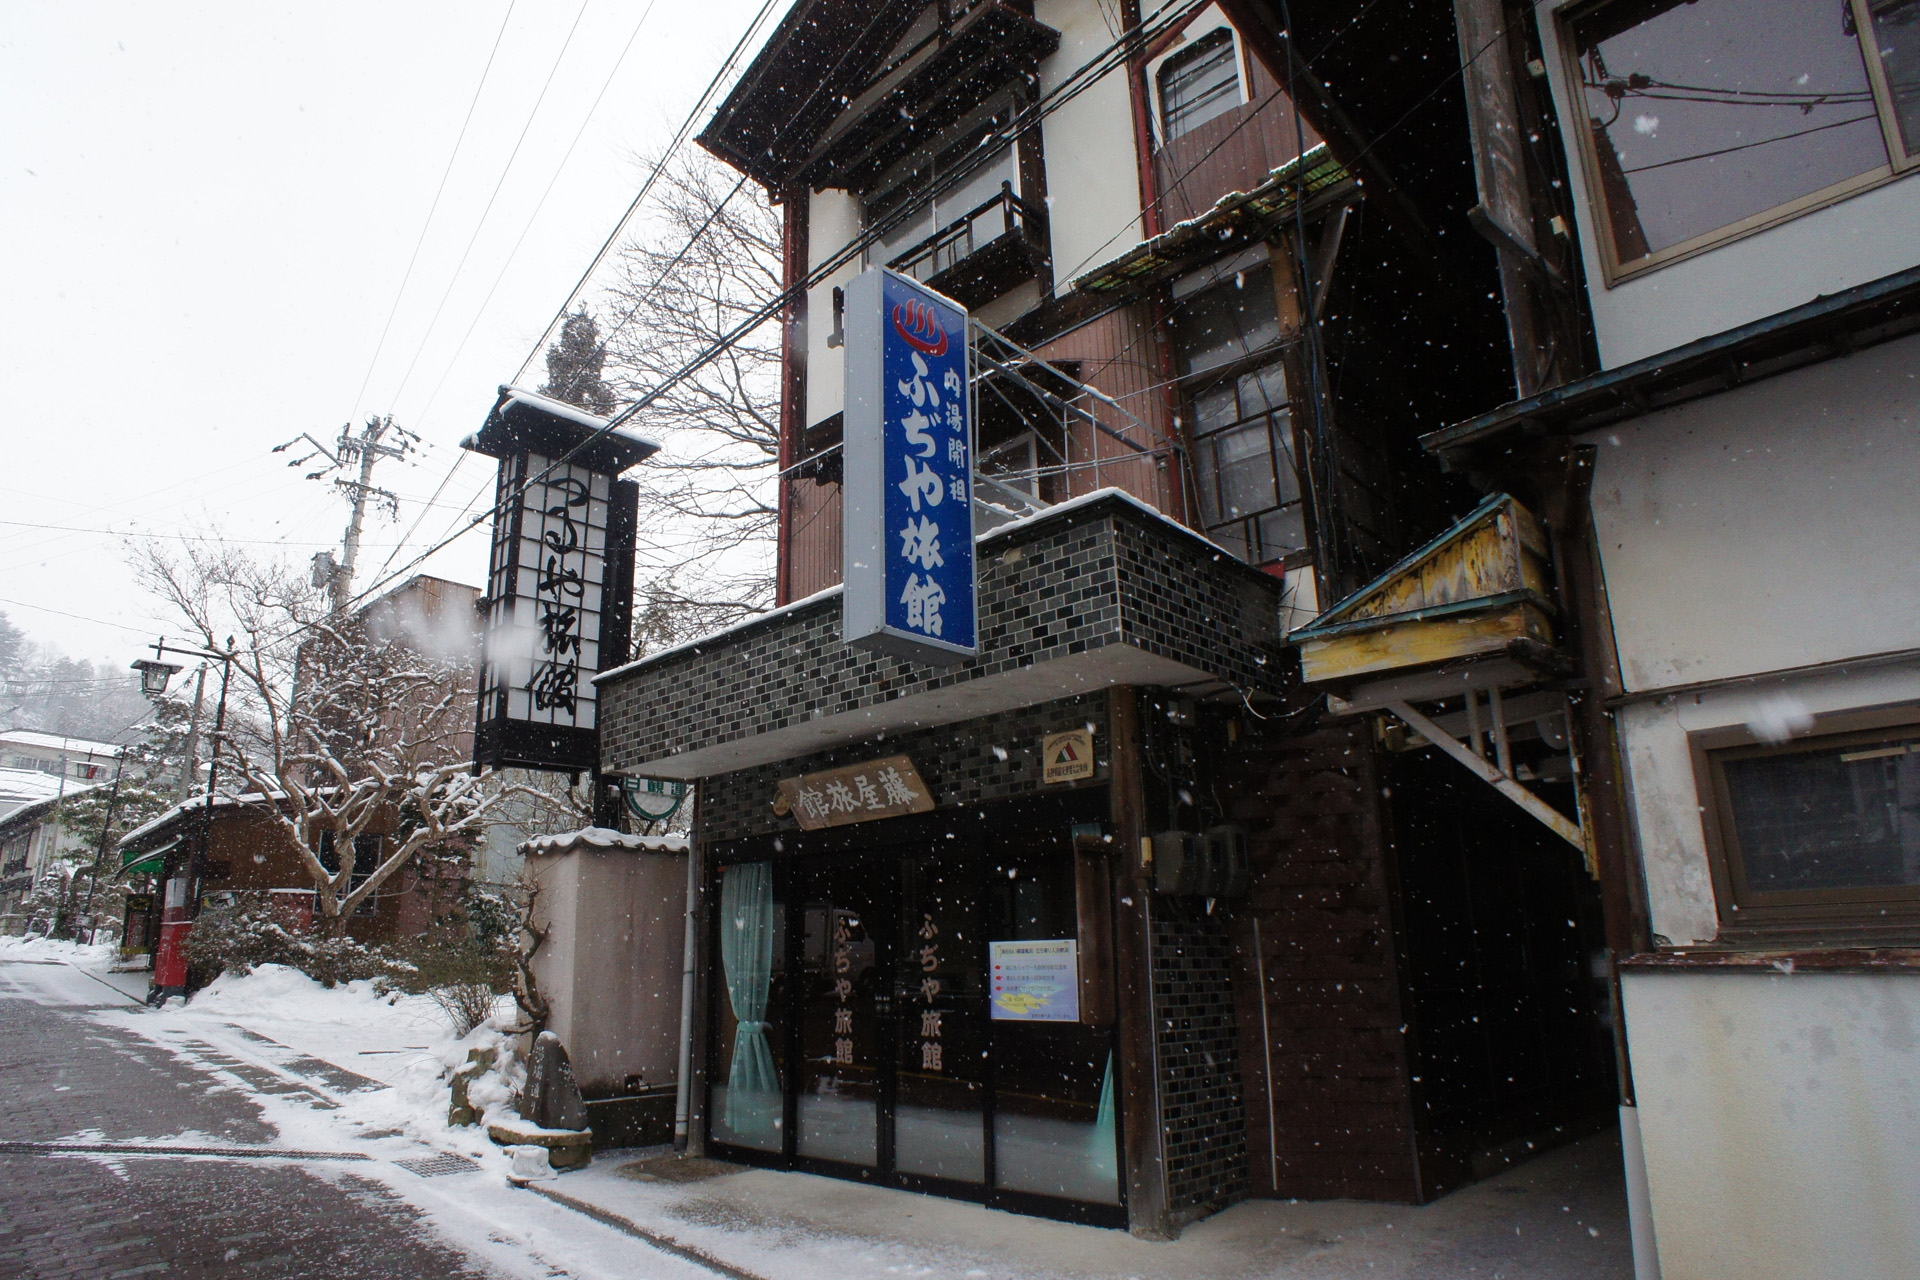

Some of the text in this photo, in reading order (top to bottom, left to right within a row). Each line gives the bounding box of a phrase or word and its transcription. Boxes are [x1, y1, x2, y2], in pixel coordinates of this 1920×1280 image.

[898, 350, 946, 638] ふぢや旅館
[944, 367, 968, 504] 内湯開祖
[834, 918, 853, 1065] ふぢや旅館
[919, 913, 943, 1071] ふぢや旅館
